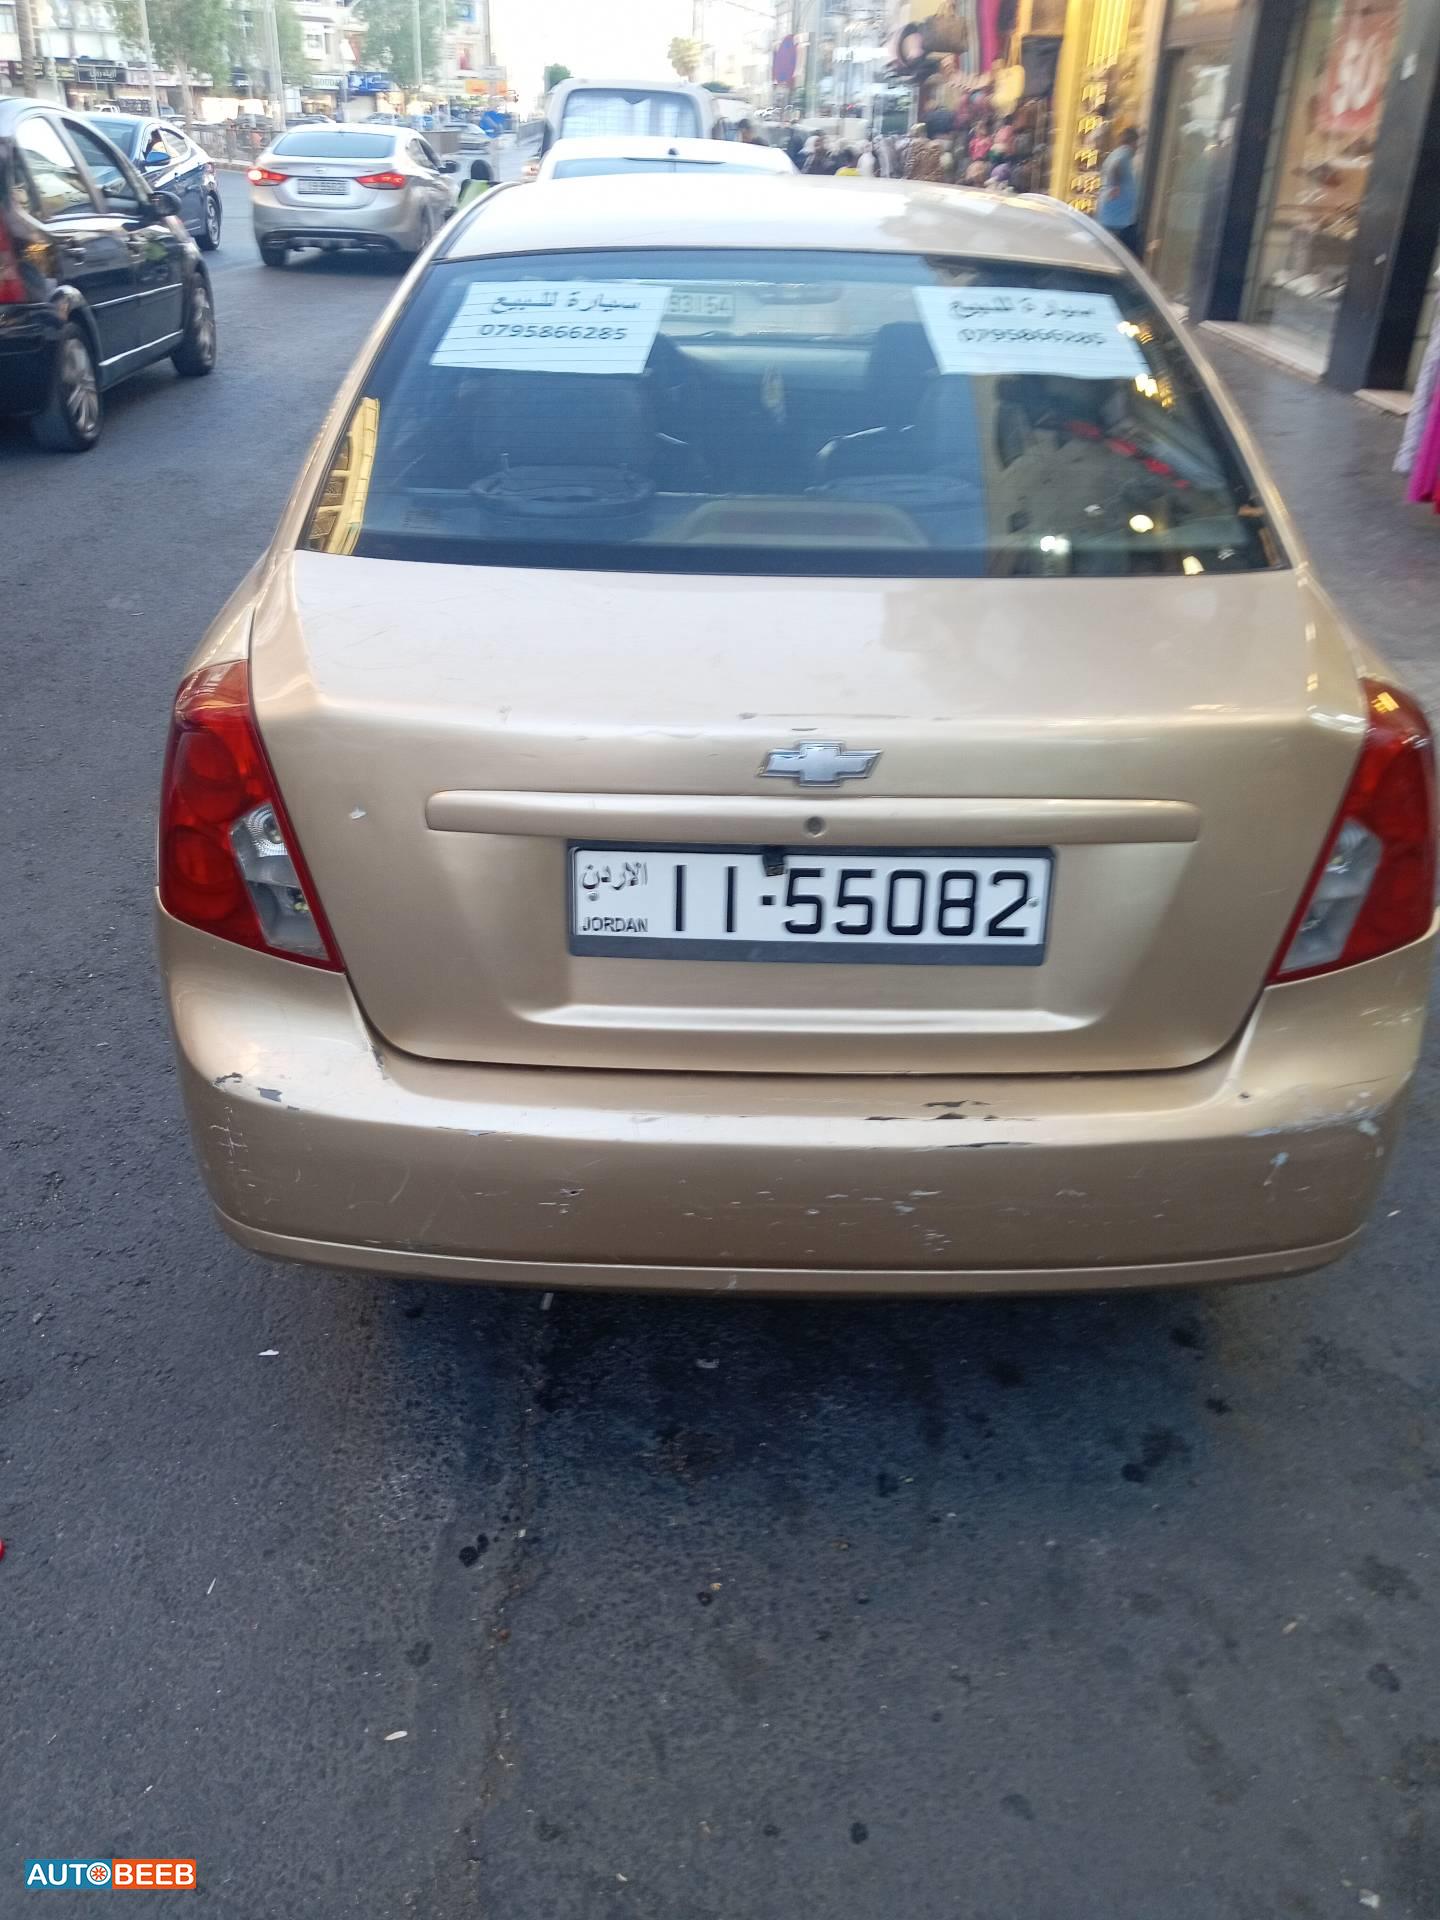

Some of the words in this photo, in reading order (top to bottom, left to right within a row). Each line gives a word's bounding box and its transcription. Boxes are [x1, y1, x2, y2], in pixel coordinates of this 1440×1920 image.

[490, 291, 559, 314] للبيع
[567, 291, 640, 312] سيارة
[479, 323, 629, 341] 0795866285
[582, 916, 648, 933] JORDAN
